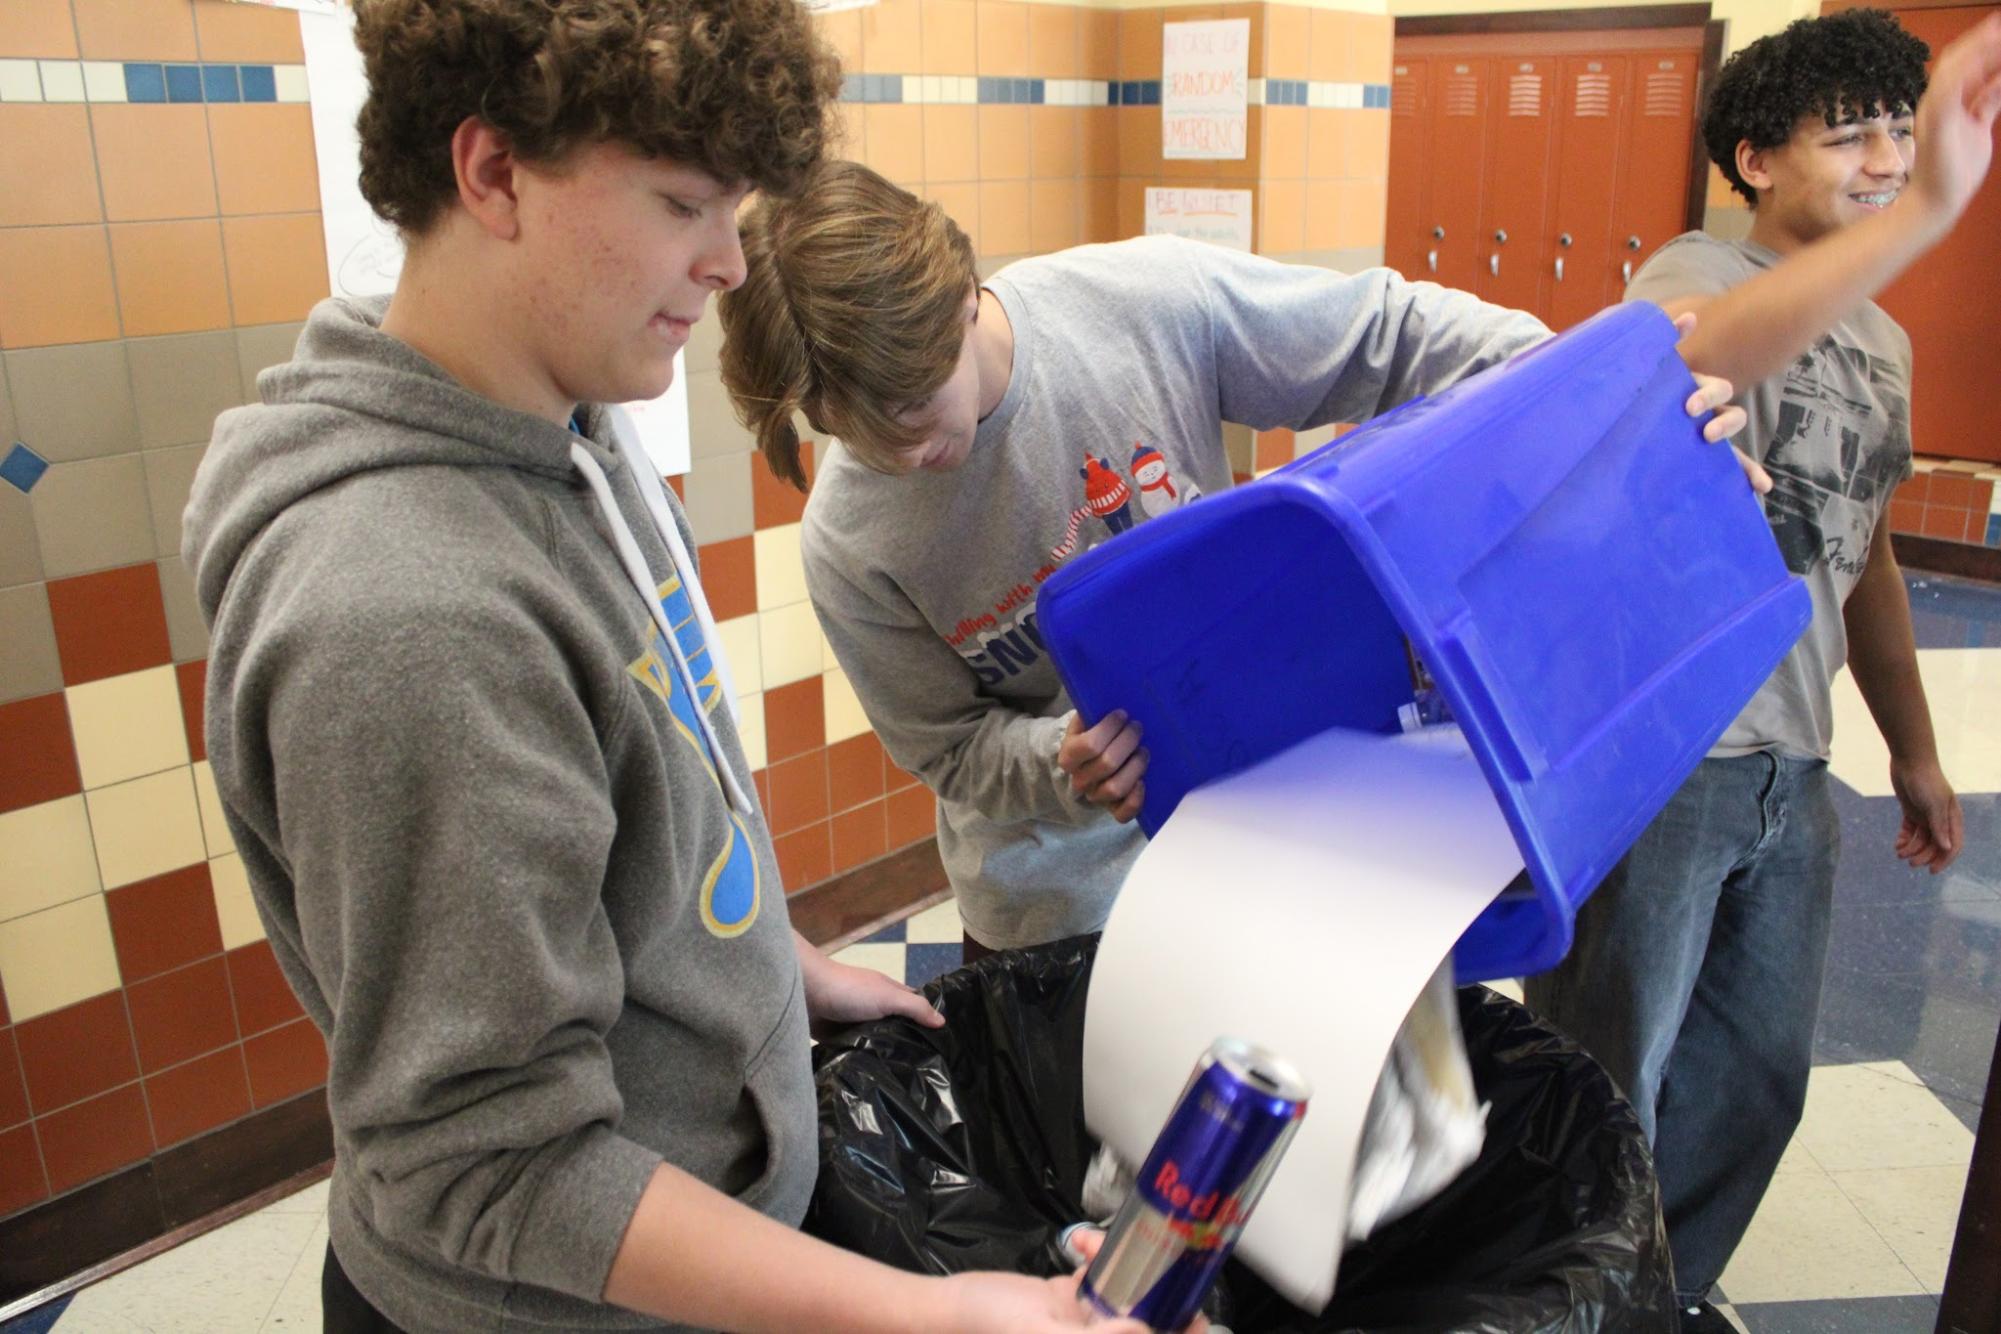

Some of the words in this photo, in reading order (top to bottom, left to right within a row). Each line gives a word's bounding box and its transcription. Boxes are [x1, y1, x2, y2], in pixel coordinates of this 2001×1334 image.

[1183, 32, 1216, 54] CASE
[1173, 70, 1234, 97] RANDOM
[1164, 116, 1246, 152] EMERGENCY
[1156, 191, 1175, 209] BE
[995, 584, 1033, 615] with
[1154, 1160, 1220, 1220] Red
